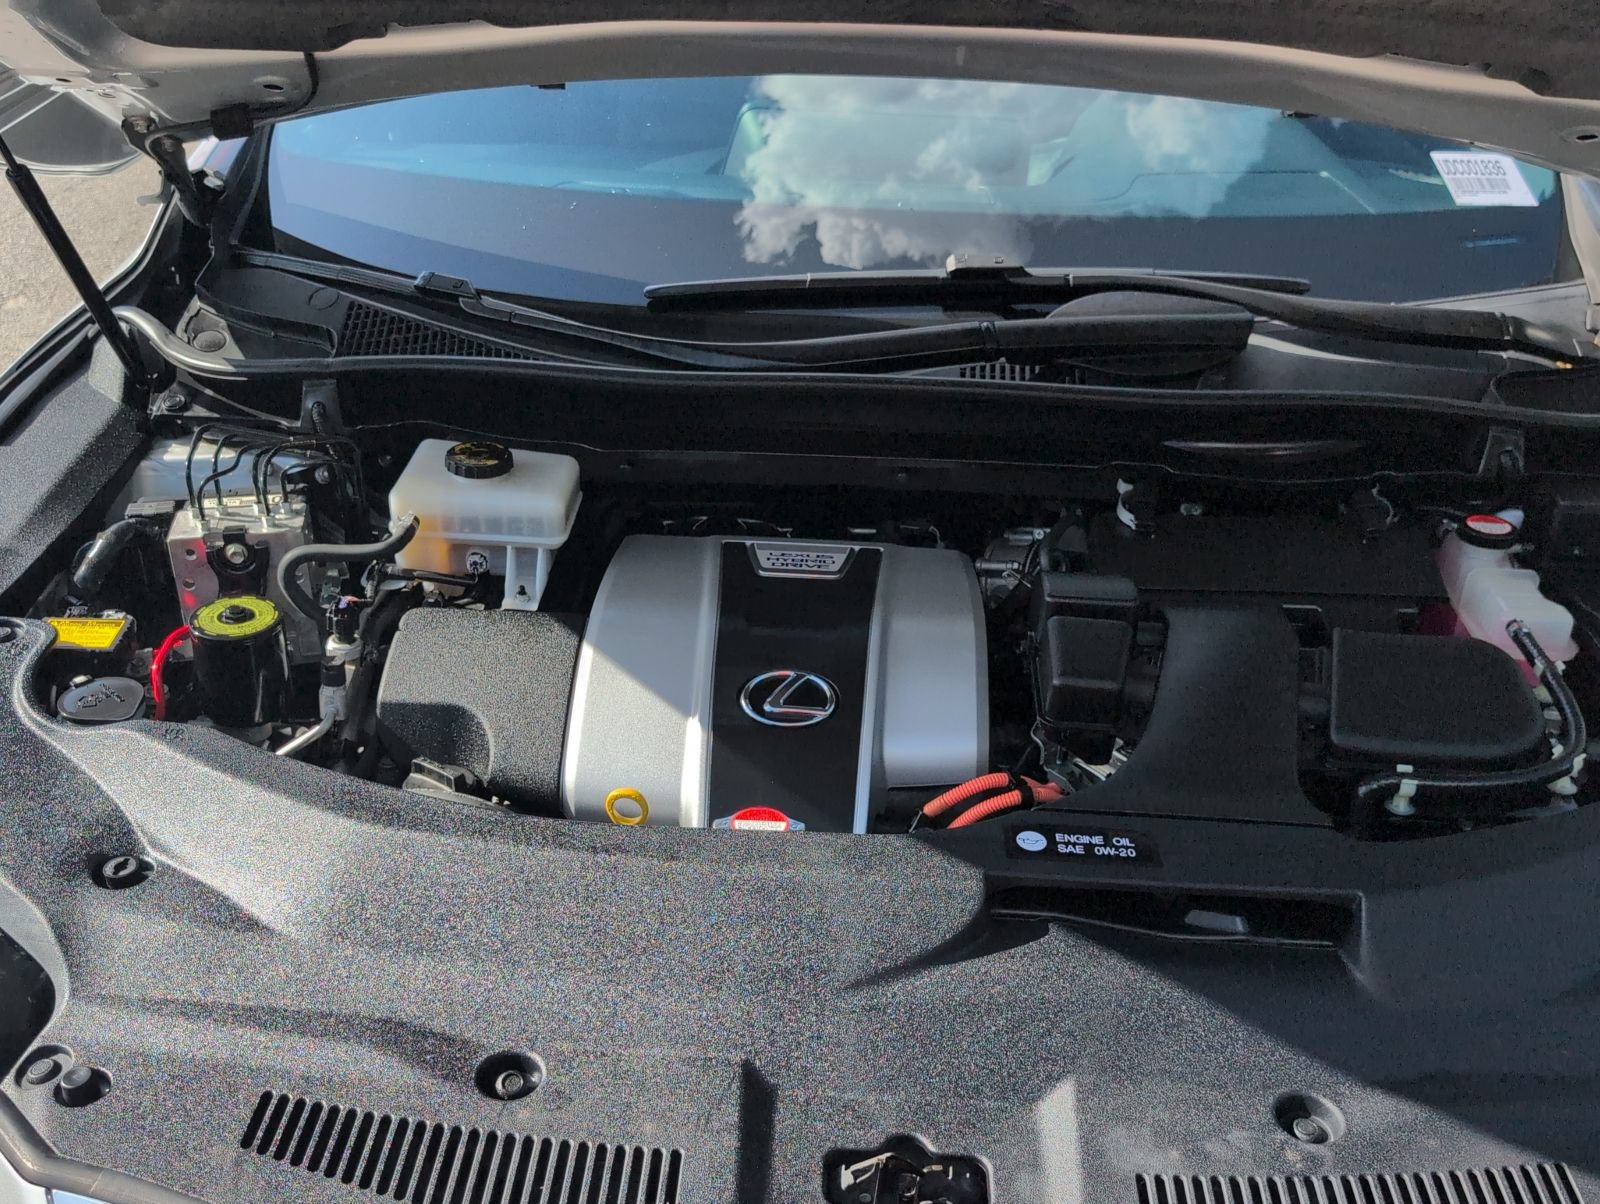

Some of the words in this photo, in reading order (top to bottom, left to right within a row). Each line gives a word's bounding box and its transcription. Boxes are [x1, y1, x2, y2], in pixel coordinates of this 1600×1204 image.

[766, 557, 836, 565] HYBRID
[1055, 833, 1105, 845] ENGINE
[1112, 837, 1136, 847] OIL
[1057, 844, 1085, 854] SAE
[1094, 846, 1137, 857] 0W-20
